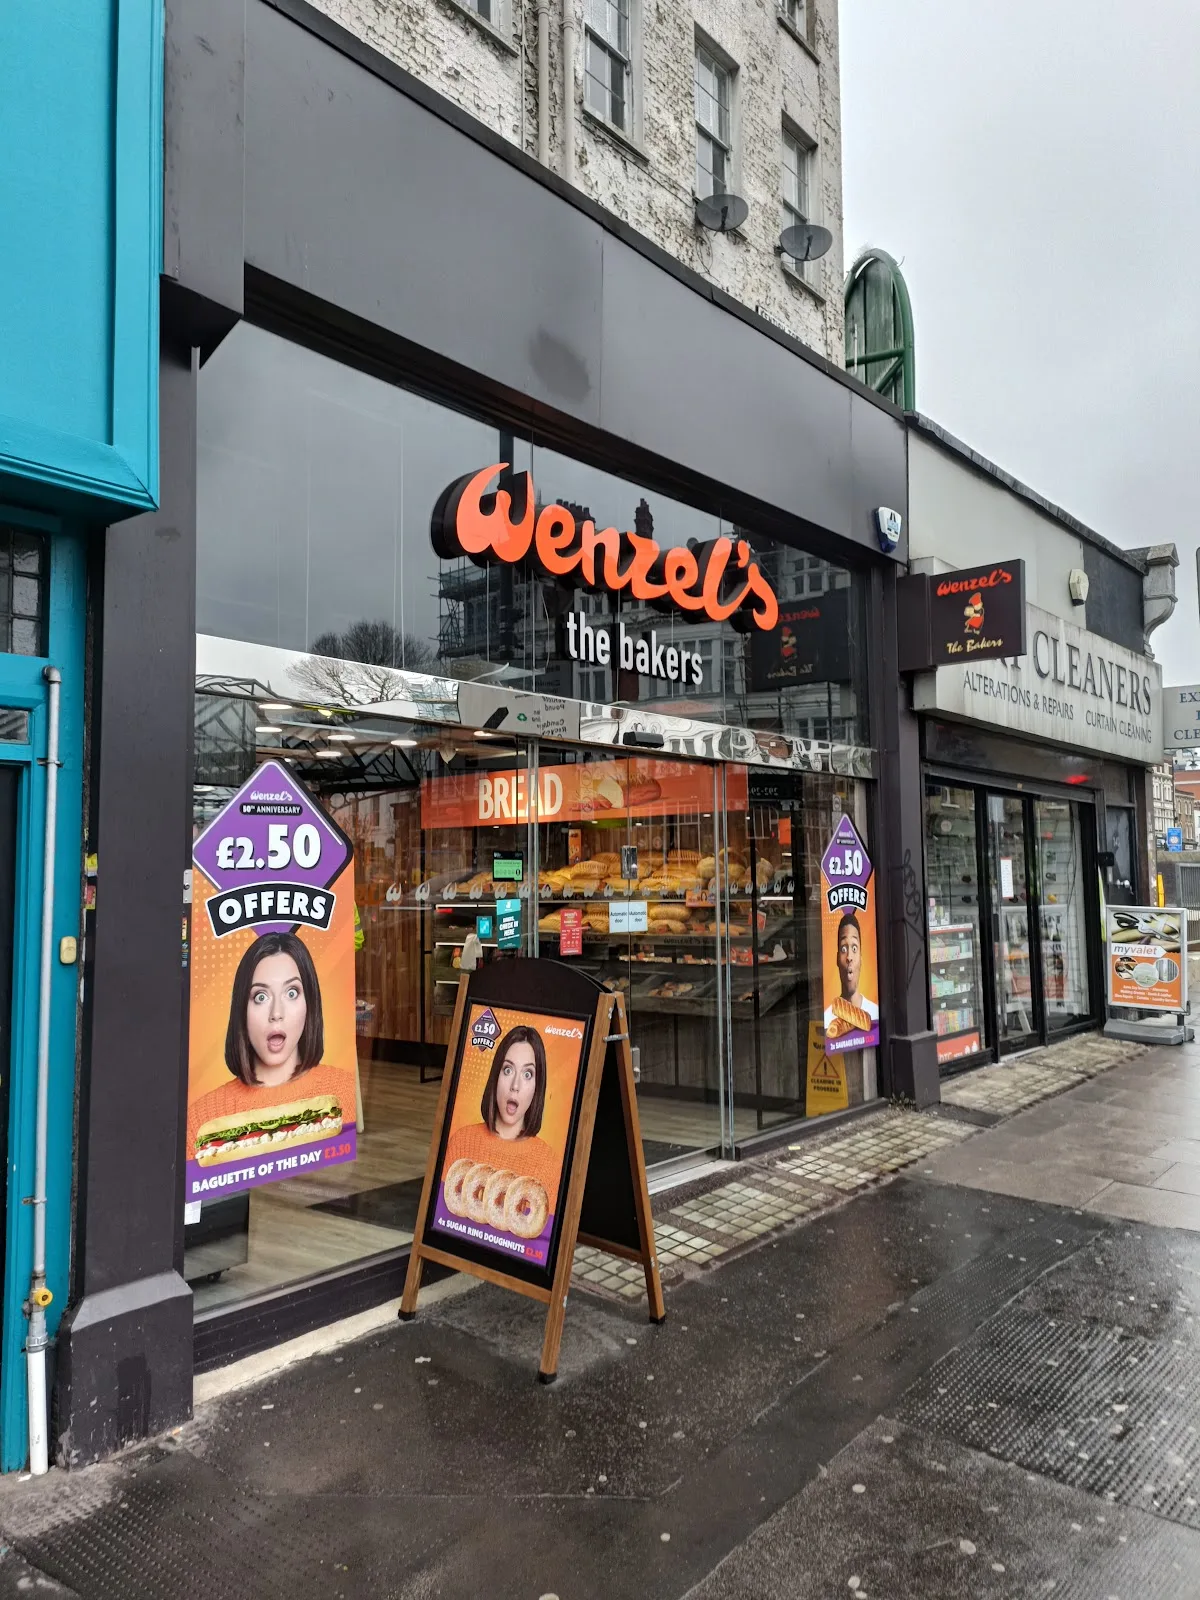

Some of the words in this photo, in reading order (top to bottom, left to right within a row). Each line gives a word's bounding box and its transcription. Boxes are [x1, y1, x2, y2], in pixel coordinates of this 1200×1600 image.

[456, 462, 779, 631] Wenzel's
[936, 569, 1013, 597] Wenzel's
[566, 611, 610, 665] the
[619, 622, 703, 686] bakers
[946, 641, 963, 654] The
[966, 637, 1004, 653] Bakers
[1033, 630, 1151, 716] CLEANERS
[964, 670, 1031, 710] ALTERATIONS
[1033, 693, 1040, 710] &
[1042, 697, 1074, 721] REPAIRS
[1085, 709, 1118, 734] CURTAIN
[1119, 720, 1152, 744] CLEANING
[250, 790, 293, 801] Wenzel's
[478, 772, 564, 820] BREAD
[256, 806, 301, 814] ANNIVERSARY
[215, 823, 322, 870] £2.50
[829, 849, 863, 876] £2.50
[218, 890, 327, 925] OFFERS
[830, 887, 866, 906] OFFERS
[1114, 945, 1158, 956] myvalet
[473, 1037, 494, 1048] OFFERS
[474, 1022, 496, 1035] £2.50
[544, 1024, 583, 1040] Wenzel's
[192, 1166, 256, 1194] BAGUETTE
[257, 1161, 274, 1176] OF
[276, 1157, 298, 1172] THE
[299, 1149, 322, 1165] DAY
[437, 1217, 446, 1227] 4x
[446, 1219, 467, 1234] SUGAR
[467, 1226, 484, 1240] RING
[483, 1232, 525, 1254] DOUGHNUTS
